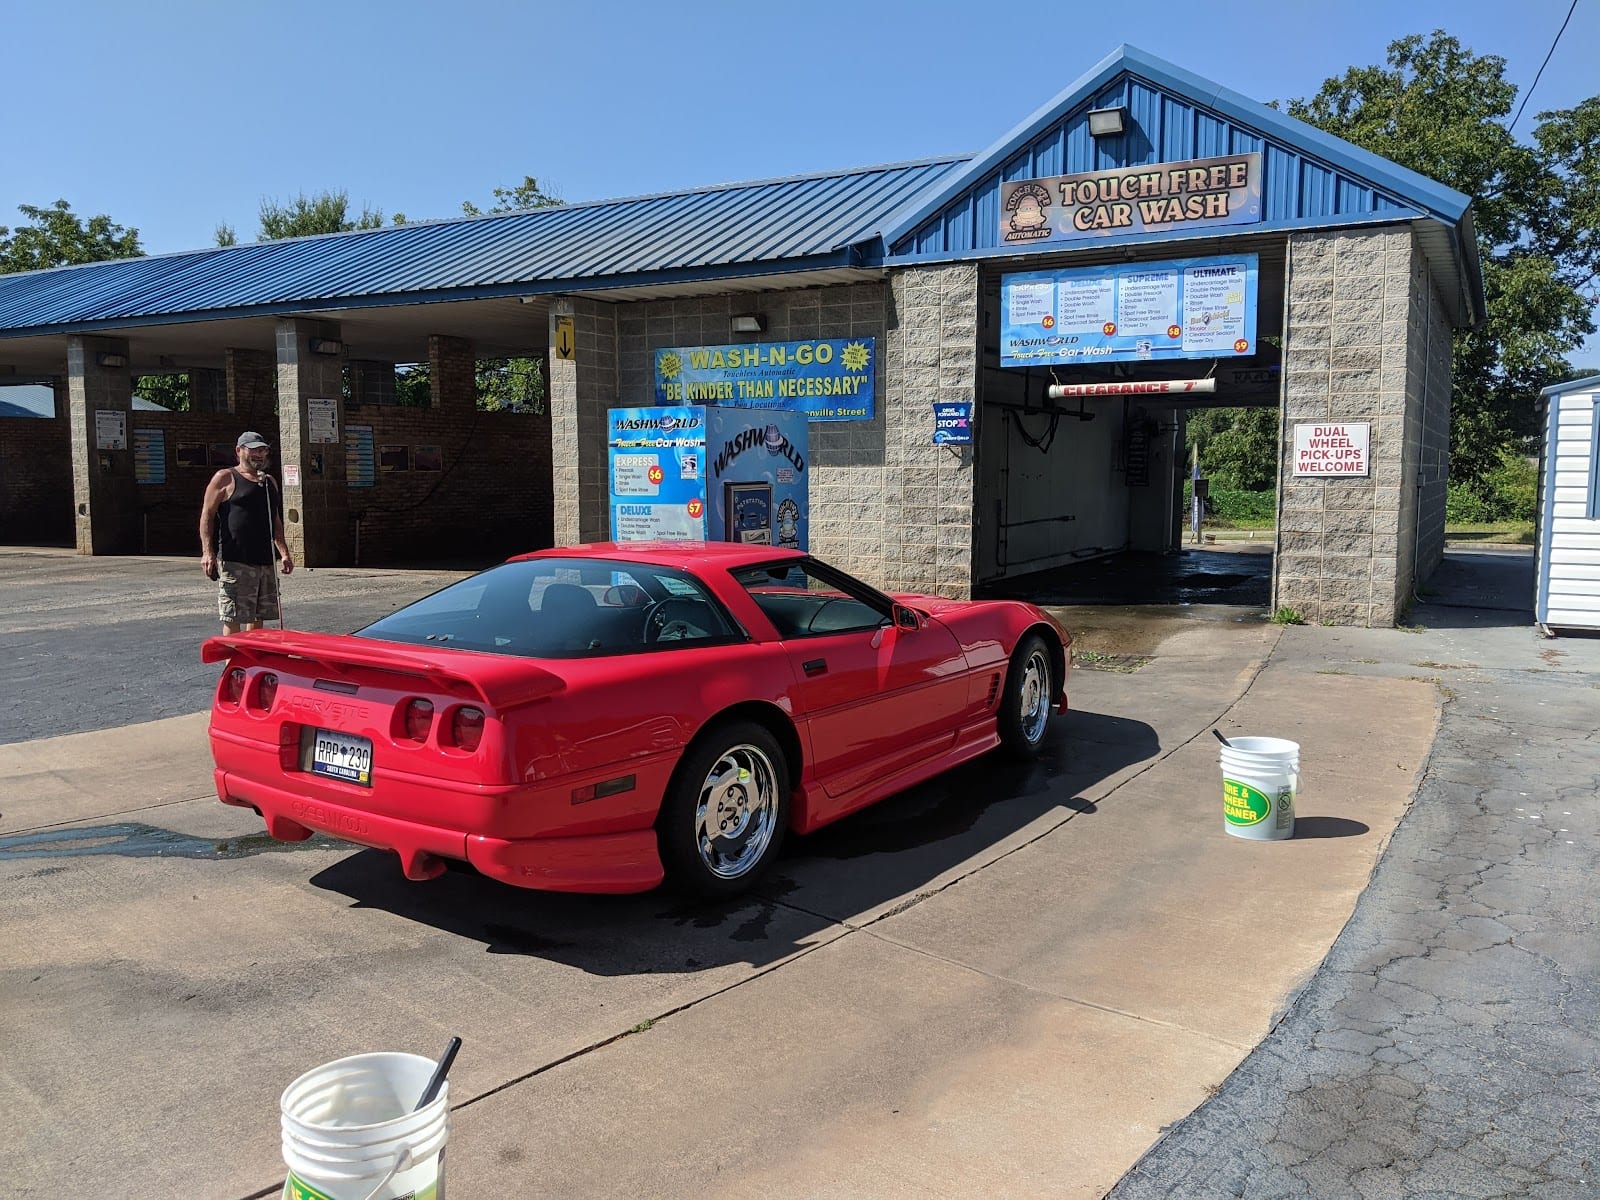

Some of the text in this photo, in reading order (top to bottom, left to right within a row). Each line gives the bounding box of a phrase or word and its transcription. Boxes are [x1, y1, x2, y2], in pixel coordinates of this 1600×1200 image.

[1060, 163, 1248, 206] TOUCH FREE
[1007, 184, 1031, 210] TOUCH
[1073, 192, 1228, 232] CAR WASH
[1005, 229, 1051, 240] AUTOMATIC
[1128, 273, 1168, 283] SUPREME
[1194, 268, 1236, 278] ULTIMATE
[1043, 318, 1053, 327] $6
[1104, 325, 1115, 333] $7
[1169, 327, 1180, 336] $8
[1010, 336, 1079, 347] WASHWORLD
[1236, 341, 1247, 351] $9
[690, 344, 833, 370] WASH-N-GO
[1011, 350, 1034, 360] Touch
[1059, 348, 1080, 357] Car
[1082, 345, 1112, 356] Wash
[723, 368, 796, 378] Touchless Automatic
[661, 376, 868, 400] "BE KINDER THAN NECESSARY"
[1064, 383, 1169, 396] CLEARANCE
[750, 400, 786, 409] Locations
[837, 408, 866, 416] Street
[616, 416, 699, 432] WASHWORLD
[938, 420, 958, 428] STOP
[1314, 426, 1348, 436] DUAL
[656, 438, 674, 448] Car
[675, 437, 700, 447] Wash
[1309, 438, 1354, 448] WHEEL
[714, 424, 804, 478] WASHWORLD
[1300, 450, 1361, 460] PICK-UPS
[616, 457, 653, 467] EXPRESS
[1298, 462, 1364, 472] WELCOME
[650, 470, 662, 480] $6
[620, 506, 652, 516] DELUXE
[688, 503, 702, 514] $7
[292, 696, 368, 718] CORVETTE
[348, 746, 369, 770] 230
[326, 764, 338, 774] SOUTH
[339, 766, 357, 778] CAROLINA
[1242, 788, 1248, 798] &
